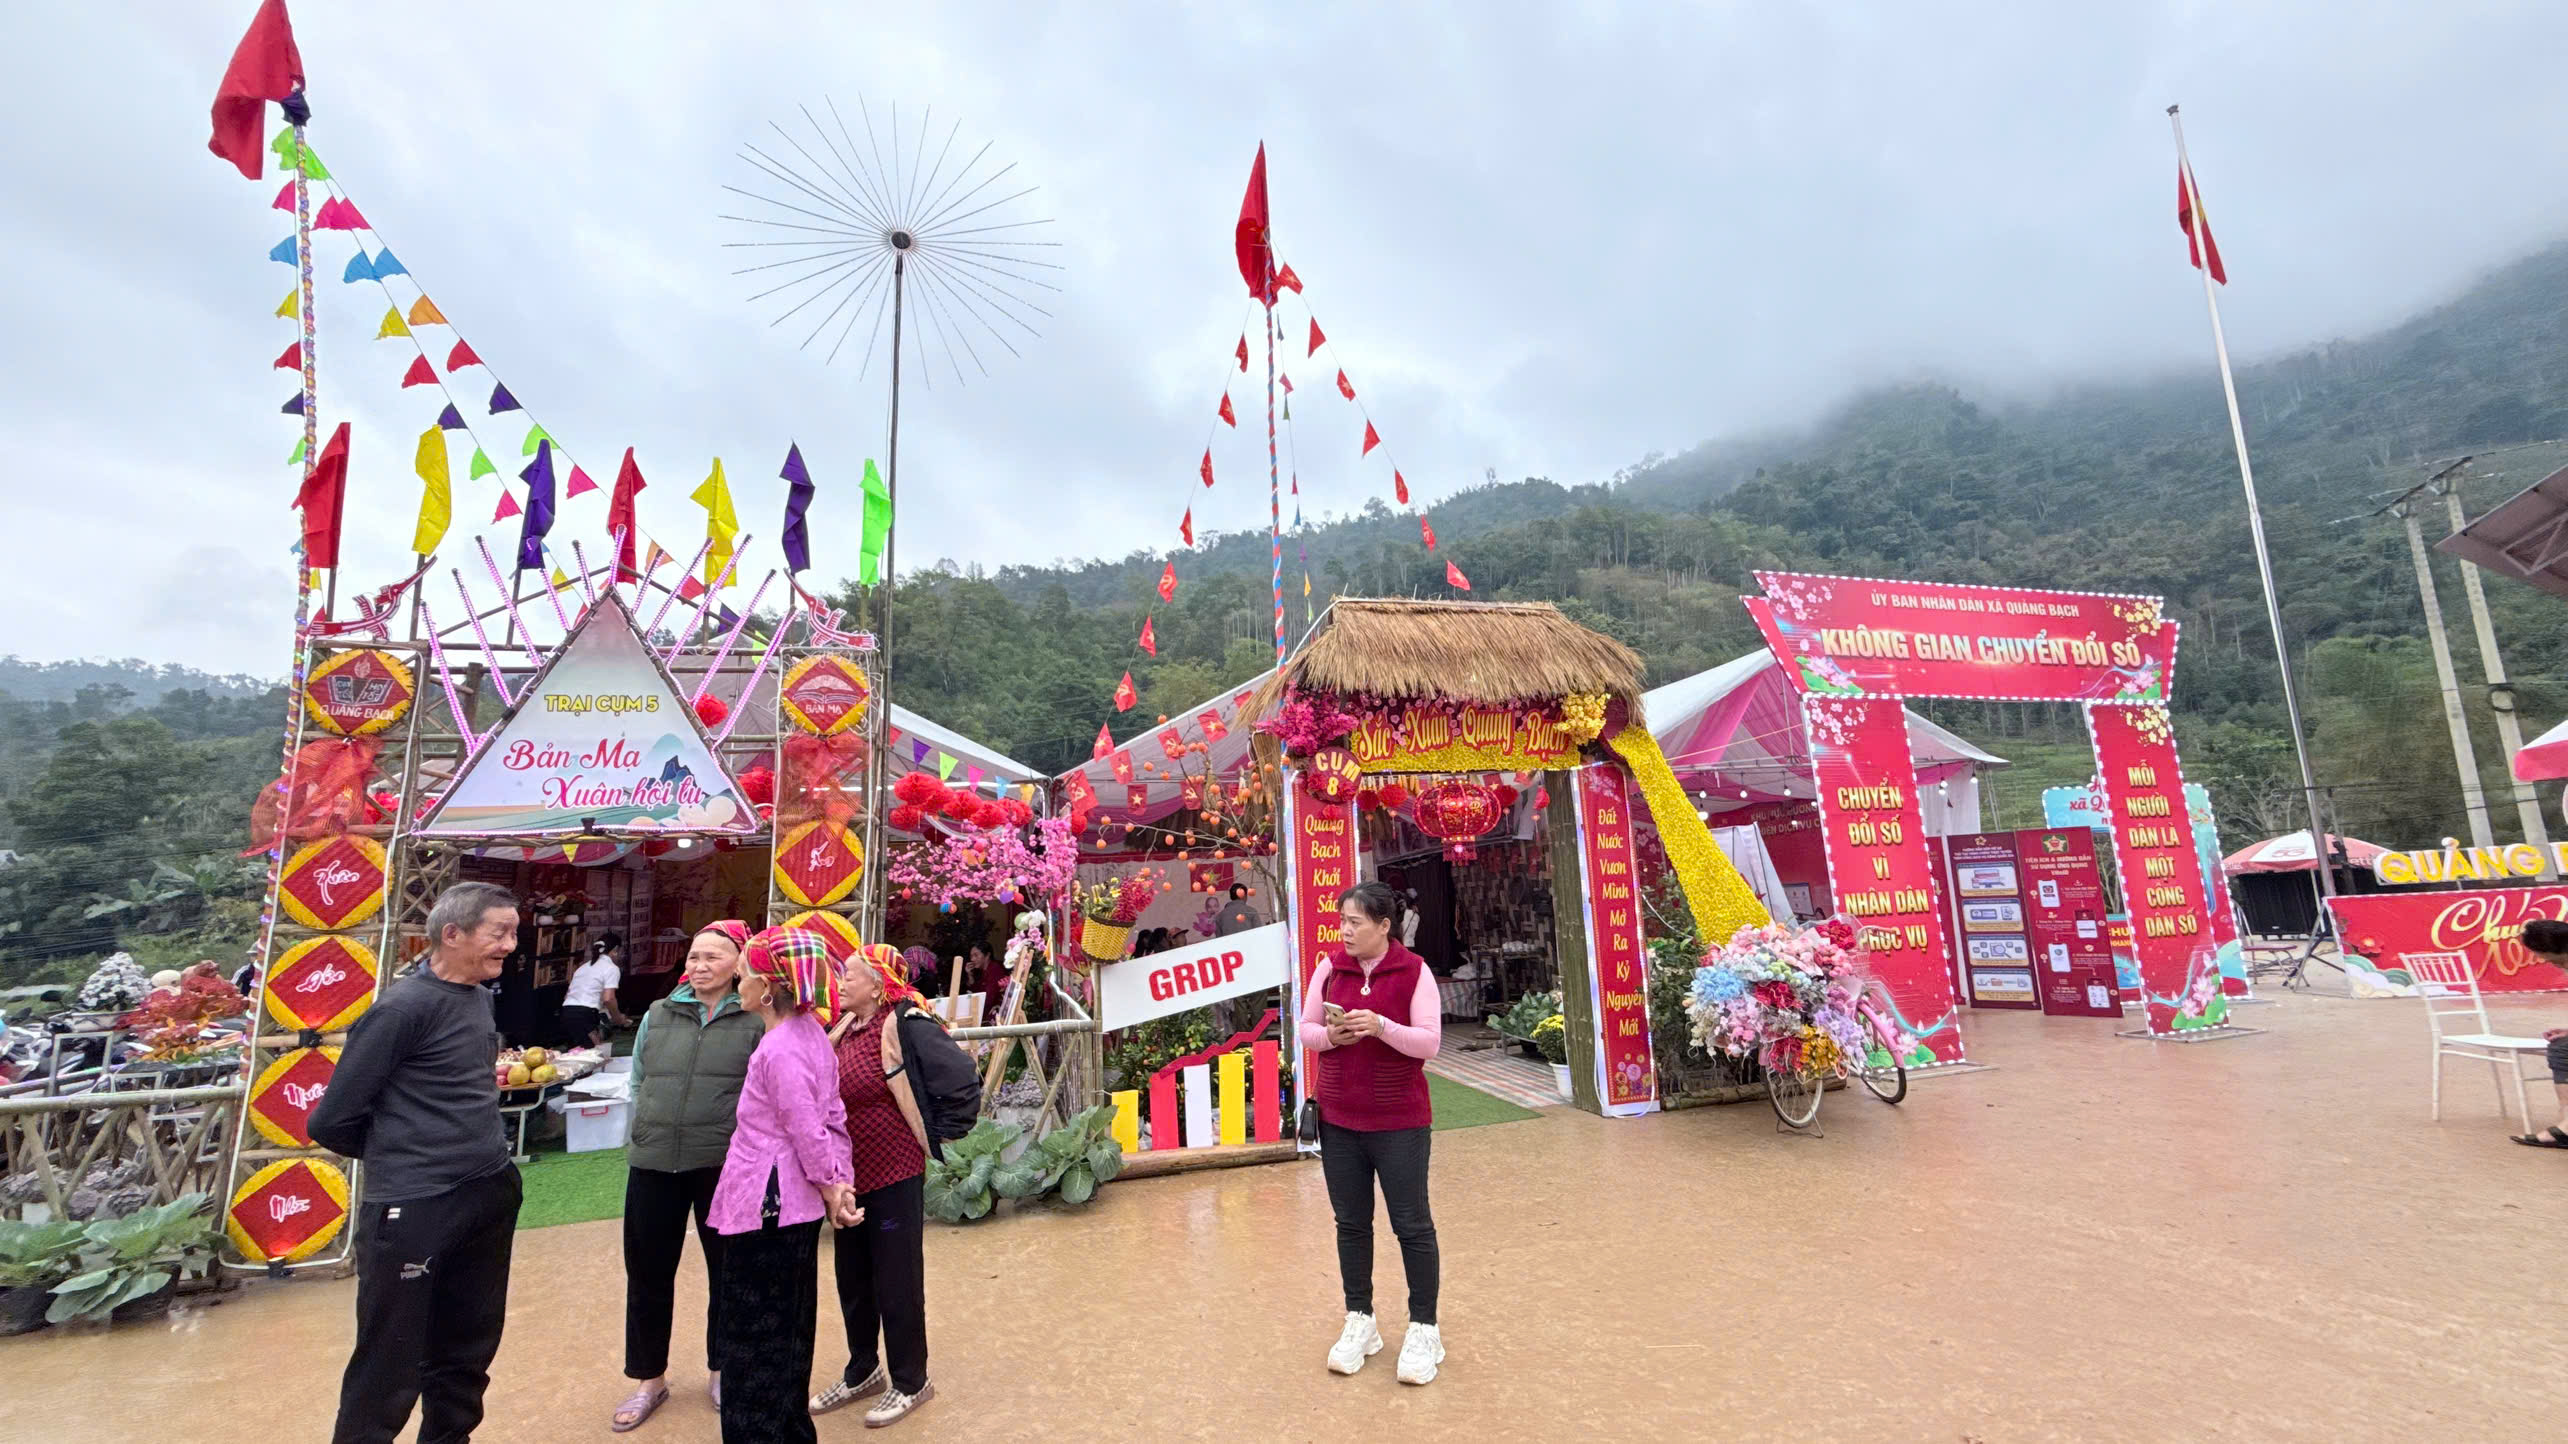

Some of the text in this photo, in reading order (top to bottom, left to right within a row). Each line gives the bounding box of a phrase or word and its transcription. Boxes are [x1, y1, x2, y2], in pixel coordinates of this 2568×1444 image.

[1891, 594, 1917, 609] BAN
[1920, 595, 1956, 611] NHÂN
[1958, 598, 1984, 613] DÂN
[2048, 603, 2080, 619] BẠCH
[1820, 623, 2142, 667] KHÔNG GIAN CHUYỂN ĐỔI SỐ
[545, 695, 659, 717] TRẠI CỤM 5
[1359, 714, 1391, 761] Sắc
[1404, 707, 1450, 752] Xuân
[503, 738, 641, 773] Bản Mạ
[1315, 751, 1361, 783] CỤM
[1327, 777, 1339, 796] 8
[2127, 760, 2158, 787] MỖI
[543, 774, 704, 812] Xuân hội tụ
[1837, 777, 1903, 811] CHUYỂN
[2126, 792, 2170, 818] NGƯỜI
[1598, 808, 1617, 825] Đất
[1849, 812, 1903, 845] ĐỔI SỐ
[1597, 831, 1624, 850] Nước
[2128, 821, 2181, 849] DÂN LÀ
[1310, 839, 1341, 862] Bạch
[2376, 837, 2545, 885] QUẢNG
[1313, 867, 1341, 887] Khởi
[1600, 858, 1627, 876] Vươn
[1872, 852, 1890, 880] VÌ
[2145, 854, 2176, 884] MỘT
[1316, 890, 1339, 914] Sắc
[1602, 880, 1629, 899] Mình
[1845, 885, 1930, 916] NHÂN DÂN
[2146, 883, 2186, 908] CÔNG
[1610, 909, 1627, 927] Mở
[2145, 907, 2198, 937] DÂN SỐ
[1613, 933, 1628, 951] Ra
[1905, 924, 1929, 953] VỤ
[1149, 950, 1243, 1002] GRDP
[1616, 959, 1631, 983] Kỷ
[1606, 989, 1646, 1013] Nguyên
[1619, 1016, 1640, 1038] Mới
